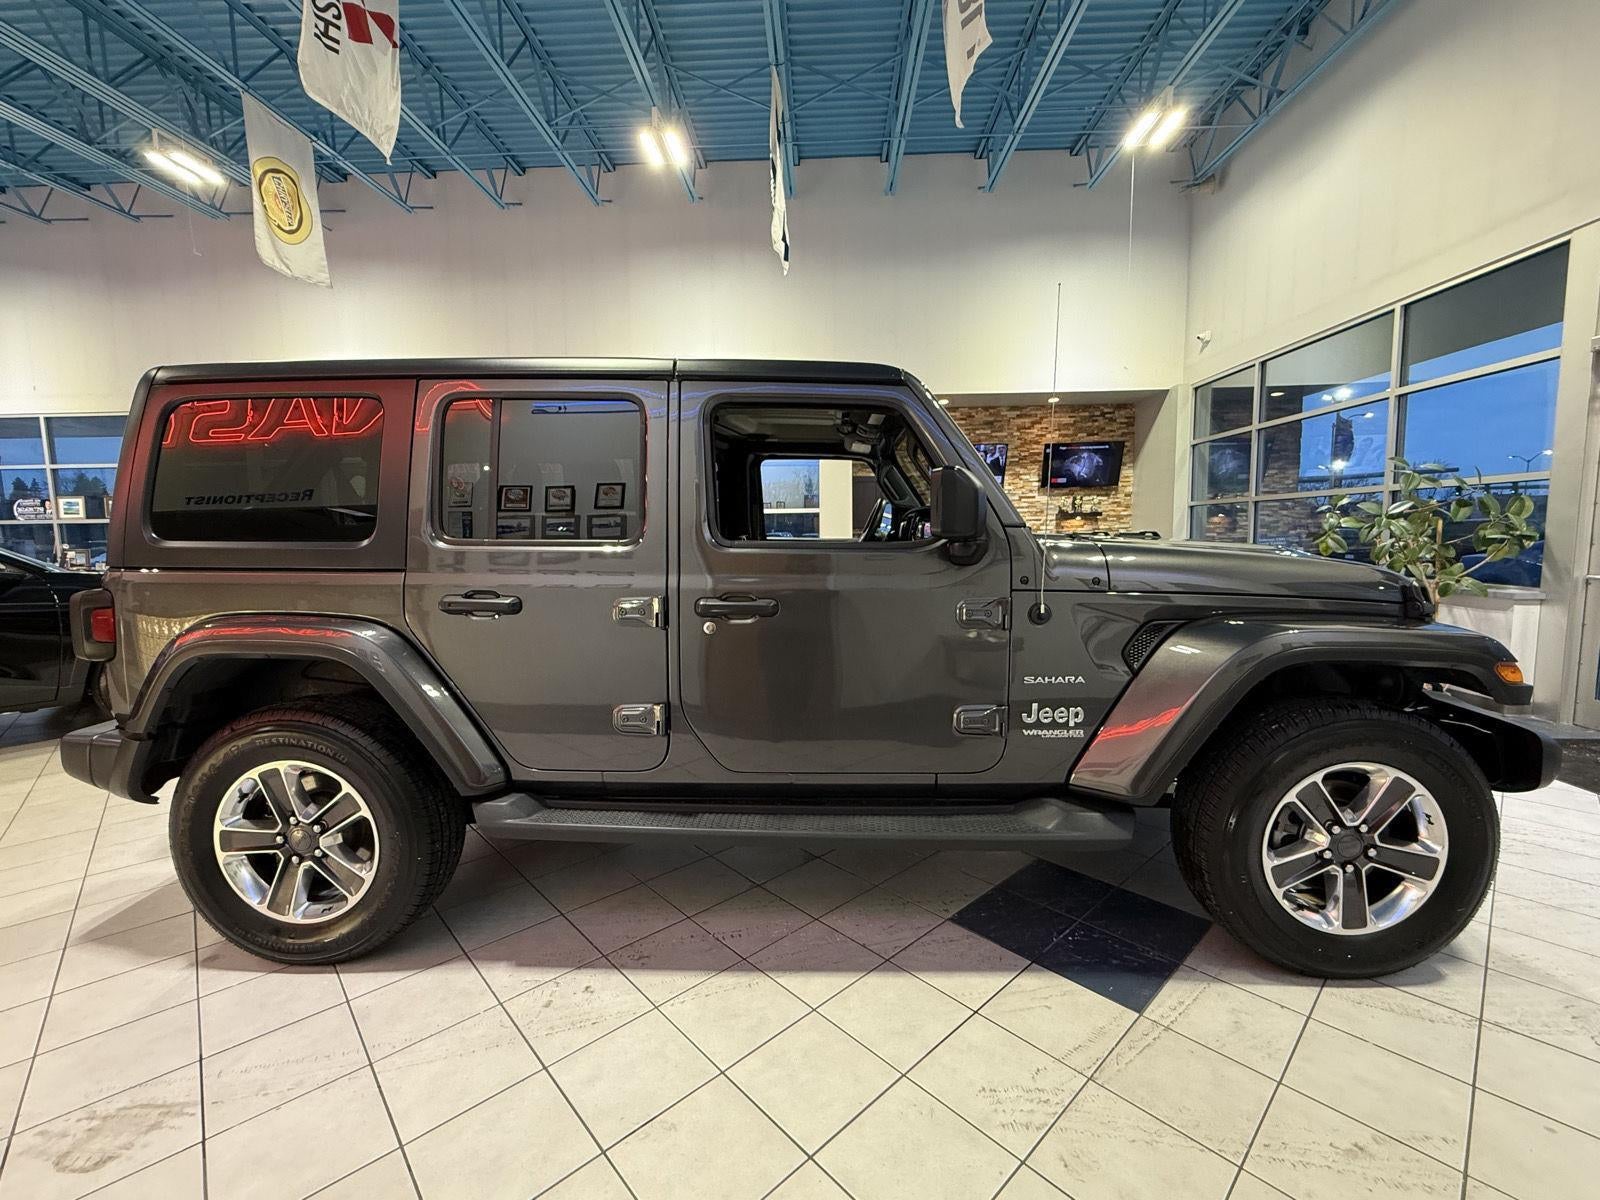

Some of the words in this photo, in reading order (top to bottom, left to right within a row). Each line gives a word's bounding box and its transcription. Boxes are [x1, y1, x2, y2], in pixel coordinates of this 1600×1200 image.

[311, 0, 342, 55] SHI
[1023, 675, 1086, 684] SAHARA
[1021, 702, 1085, 727] Jeep
[1022, 728, 1084, 736] WRANGLER
[256, 737, 335, 758] DESTINATION
